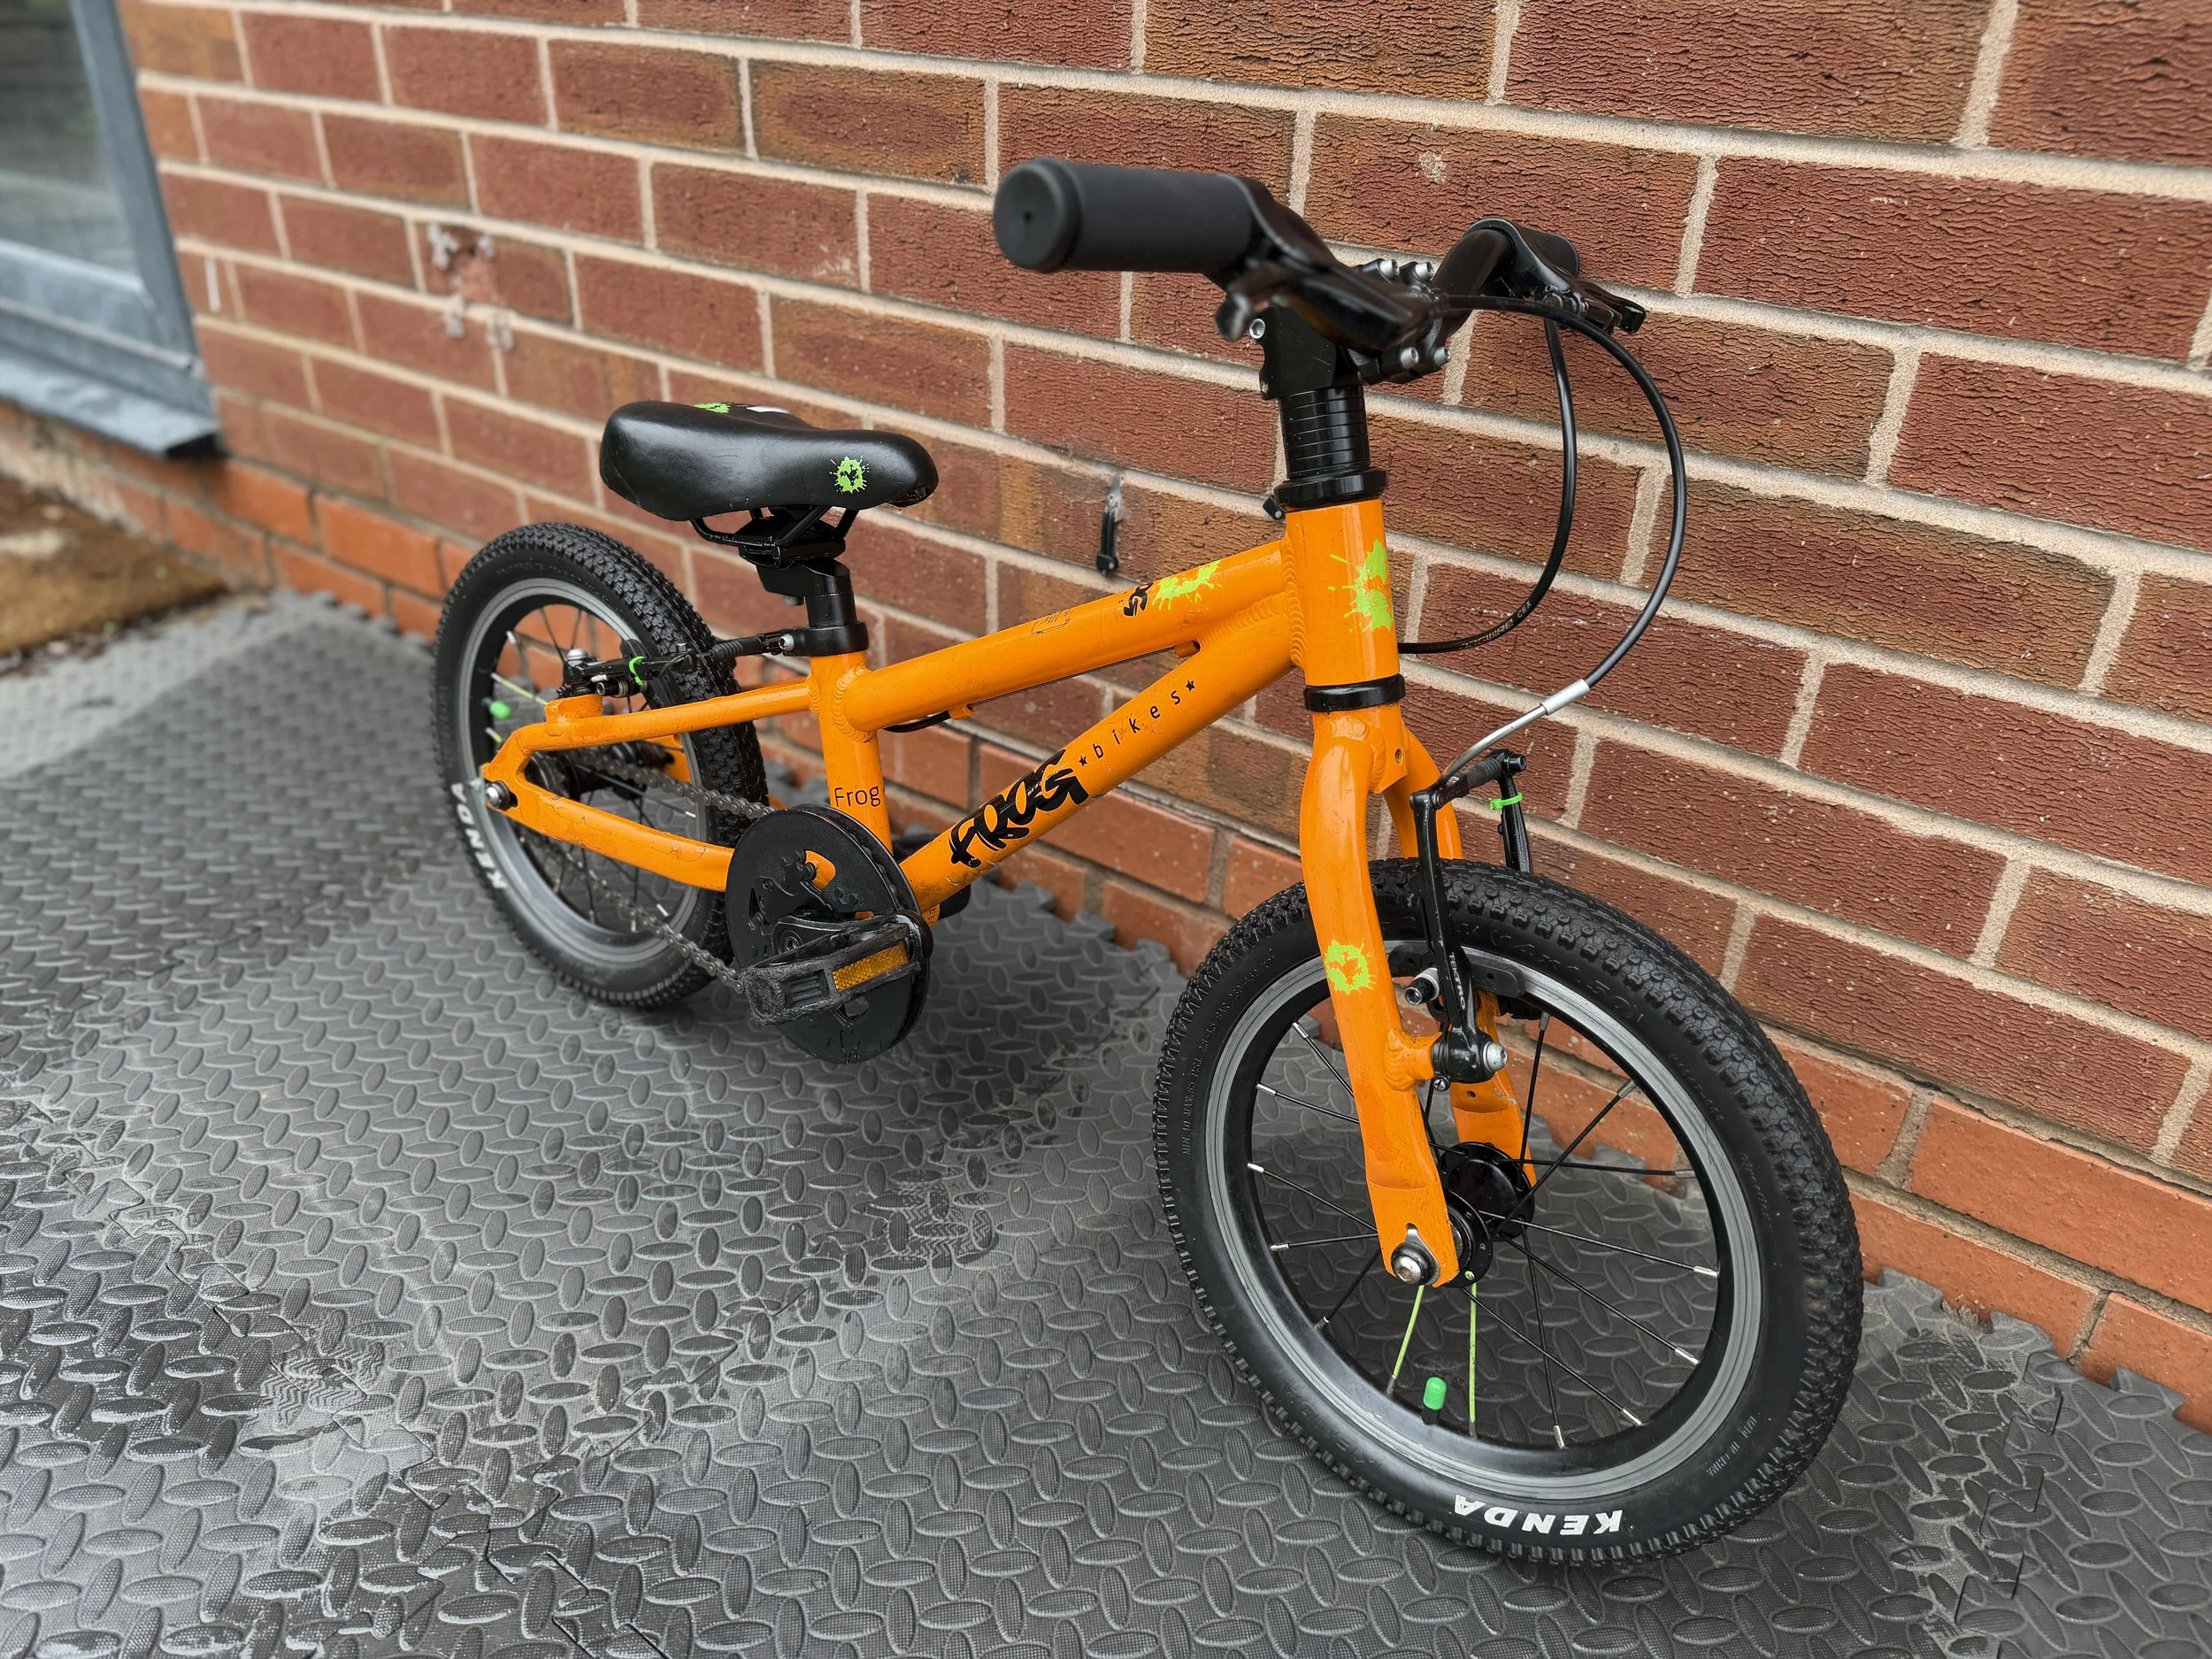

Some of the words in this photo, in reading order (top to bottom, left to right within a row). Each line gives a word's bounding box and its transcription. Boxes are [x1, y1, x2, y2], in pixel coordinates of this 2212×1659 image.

[834, 786, 880, 807] Frog
[949, 749, 1089, 868] FROG
[1094, 690, 1180, 759] bikes
[1449, 952, 1465, 1010] TEKTRO
[1454, 1494, 1623, 1536] KENDA
